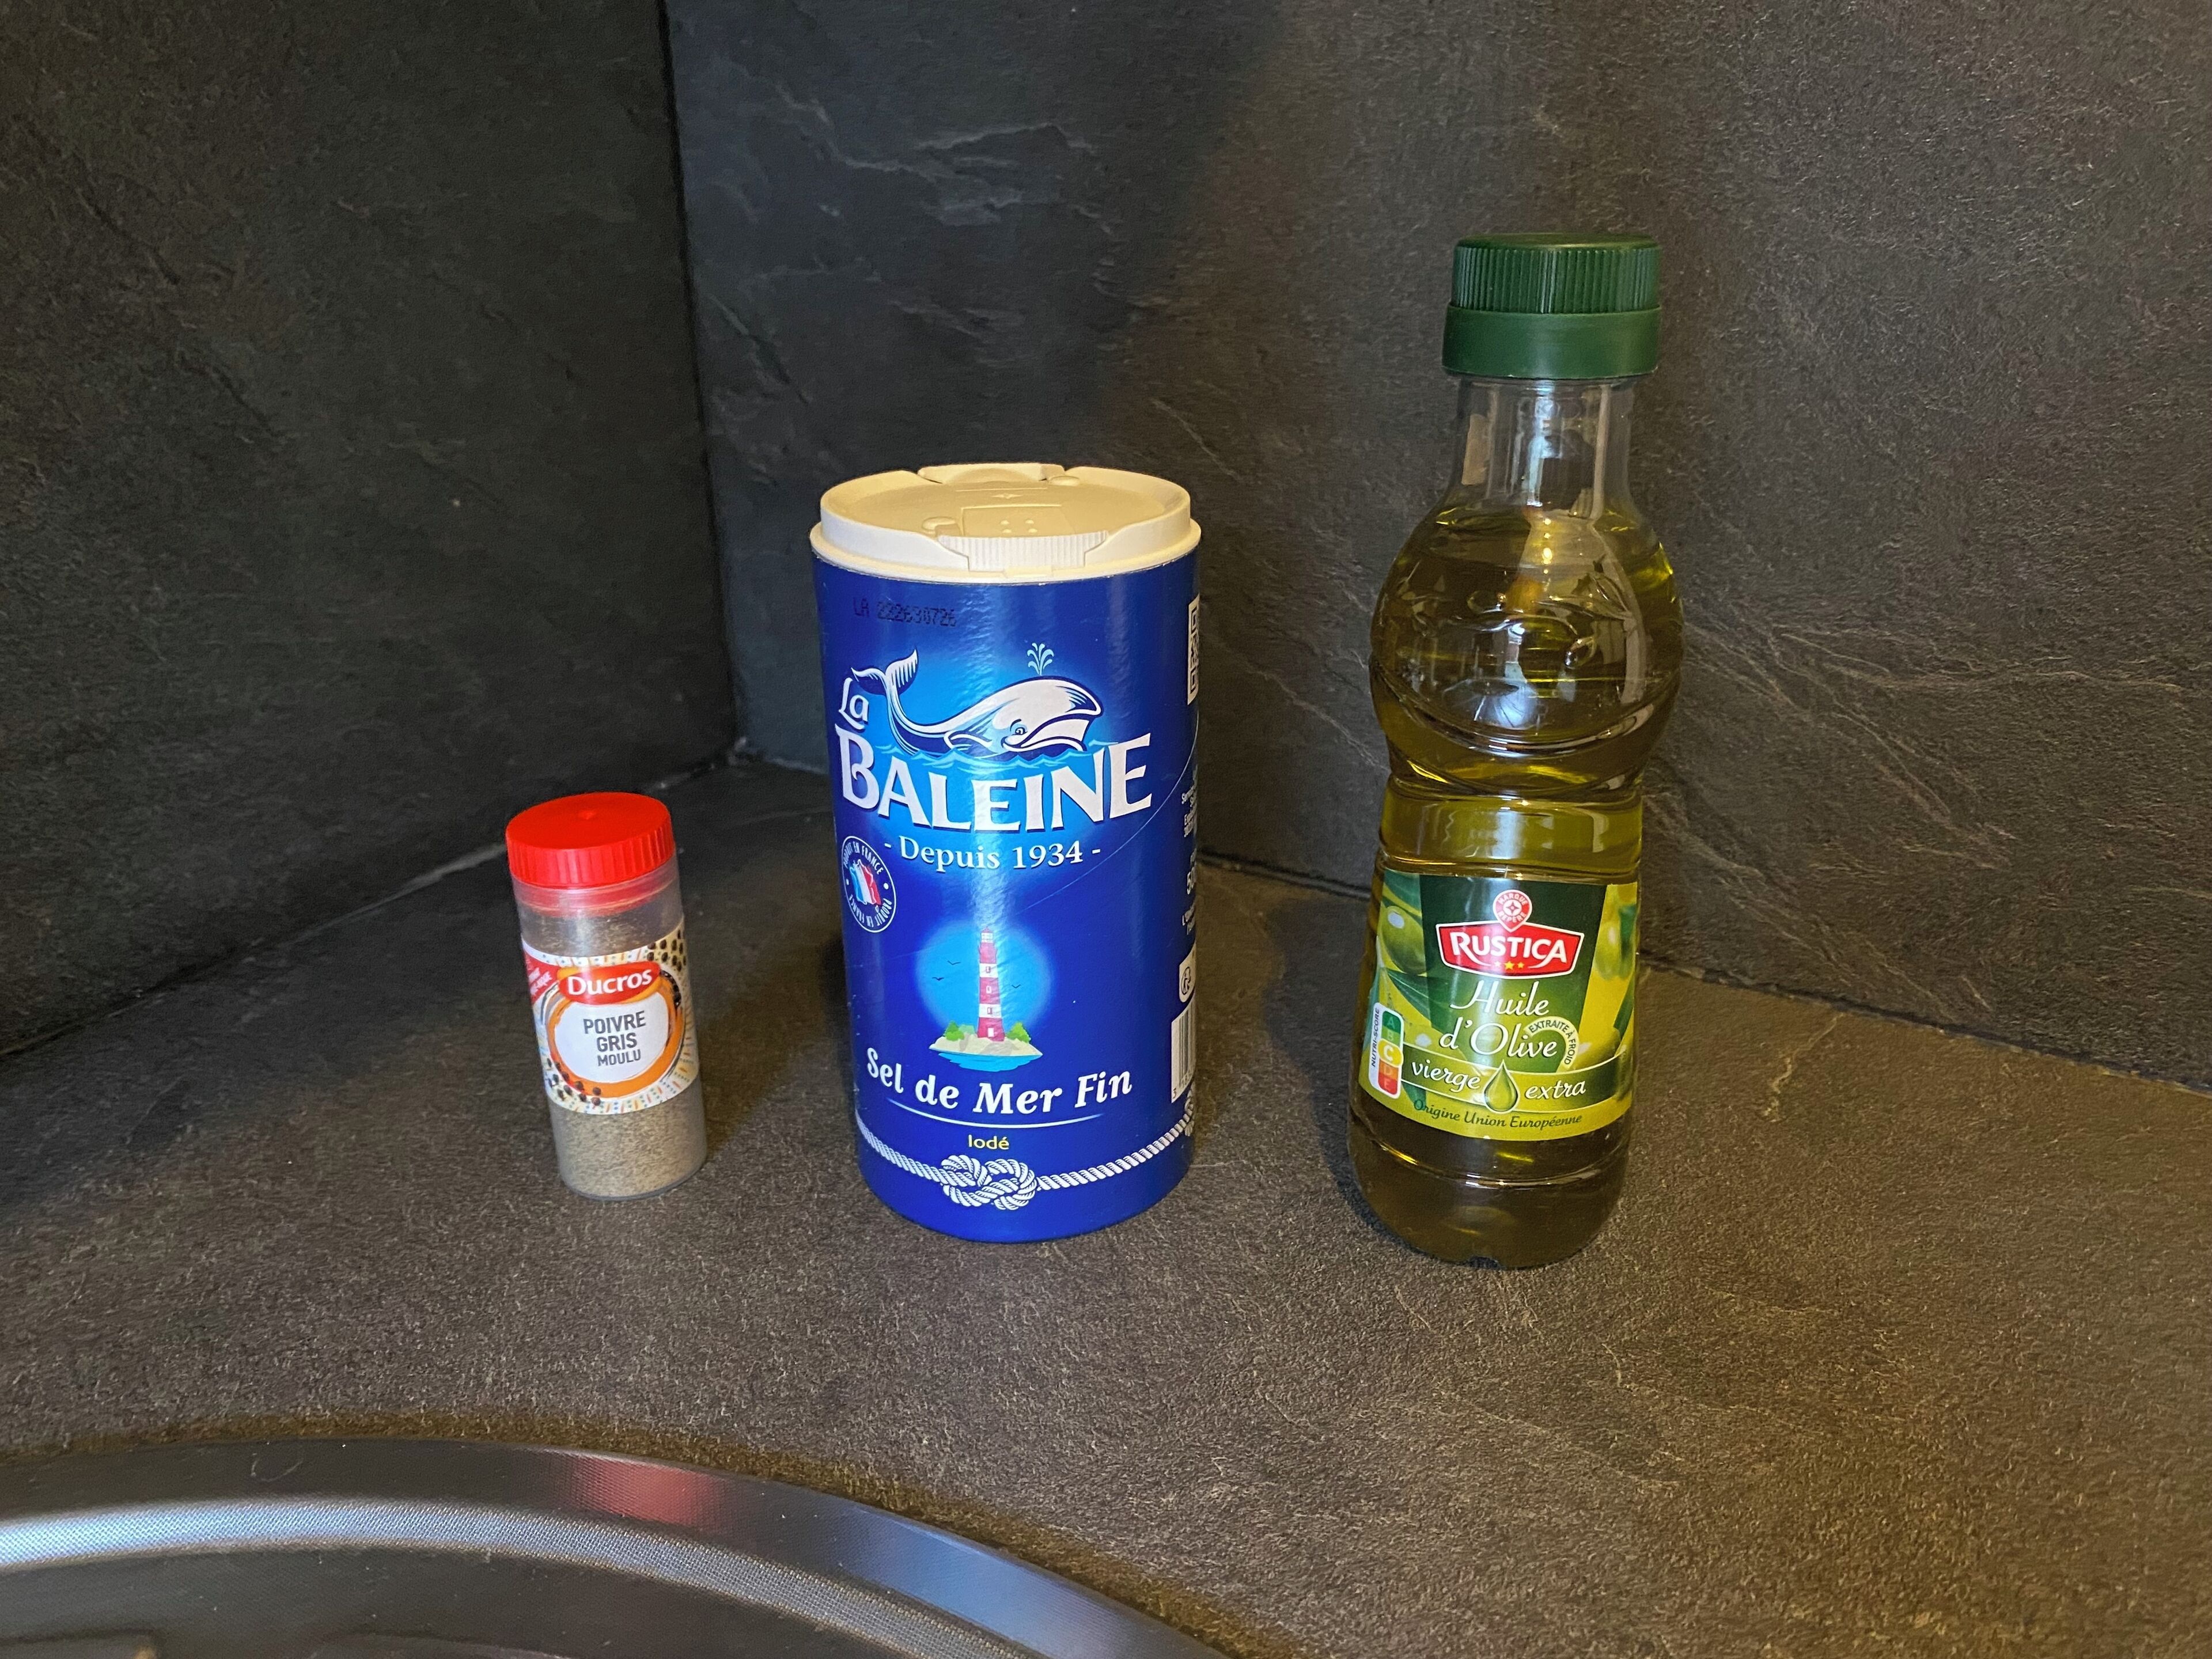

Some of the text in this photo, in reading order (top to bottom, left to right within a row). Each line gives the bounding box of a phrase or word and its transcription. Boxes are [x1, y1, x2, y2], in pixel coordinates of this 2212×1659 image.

[838, 677, 869, 730] La
[834, 722, 1153, 831] BALEINE
[853, 841, 860, 853] EN
[861, 845, 884, 874] FRANCE
[899, 835, 1001, 873] Depuis
[1013, 839, 1083, 870] 1934
[1498, 893, 1528, 906] MARQUE
[1449, 931, 1567, 969] RUSTICA
[567, 969, 653, 996] Ducros
[1449, 979, 1550, 1016] Huile
[583, 1010, 646, 1035] POIVRE
[1371, 1007, 1380, 1067] NUTRI-SCORE
[1440, 1016, 1558, 1058] d'Olive
[596, 1032, 638, 1052] GRIS
[597, 1049, 641, 1066] MOULU
[1528, 1020, 1570, 1033] EXTRAITE
[1564, 1039, 1576, 1065] FROID
[866, 1047, 1133, 1115] Sel de Mer Fin
[1412, 1059, 1586, 1100] vierge extra
[1414, 1100, 1582, 1131] Origine Union Européenne
[967, 1134, 1010, 1150] Iodé
